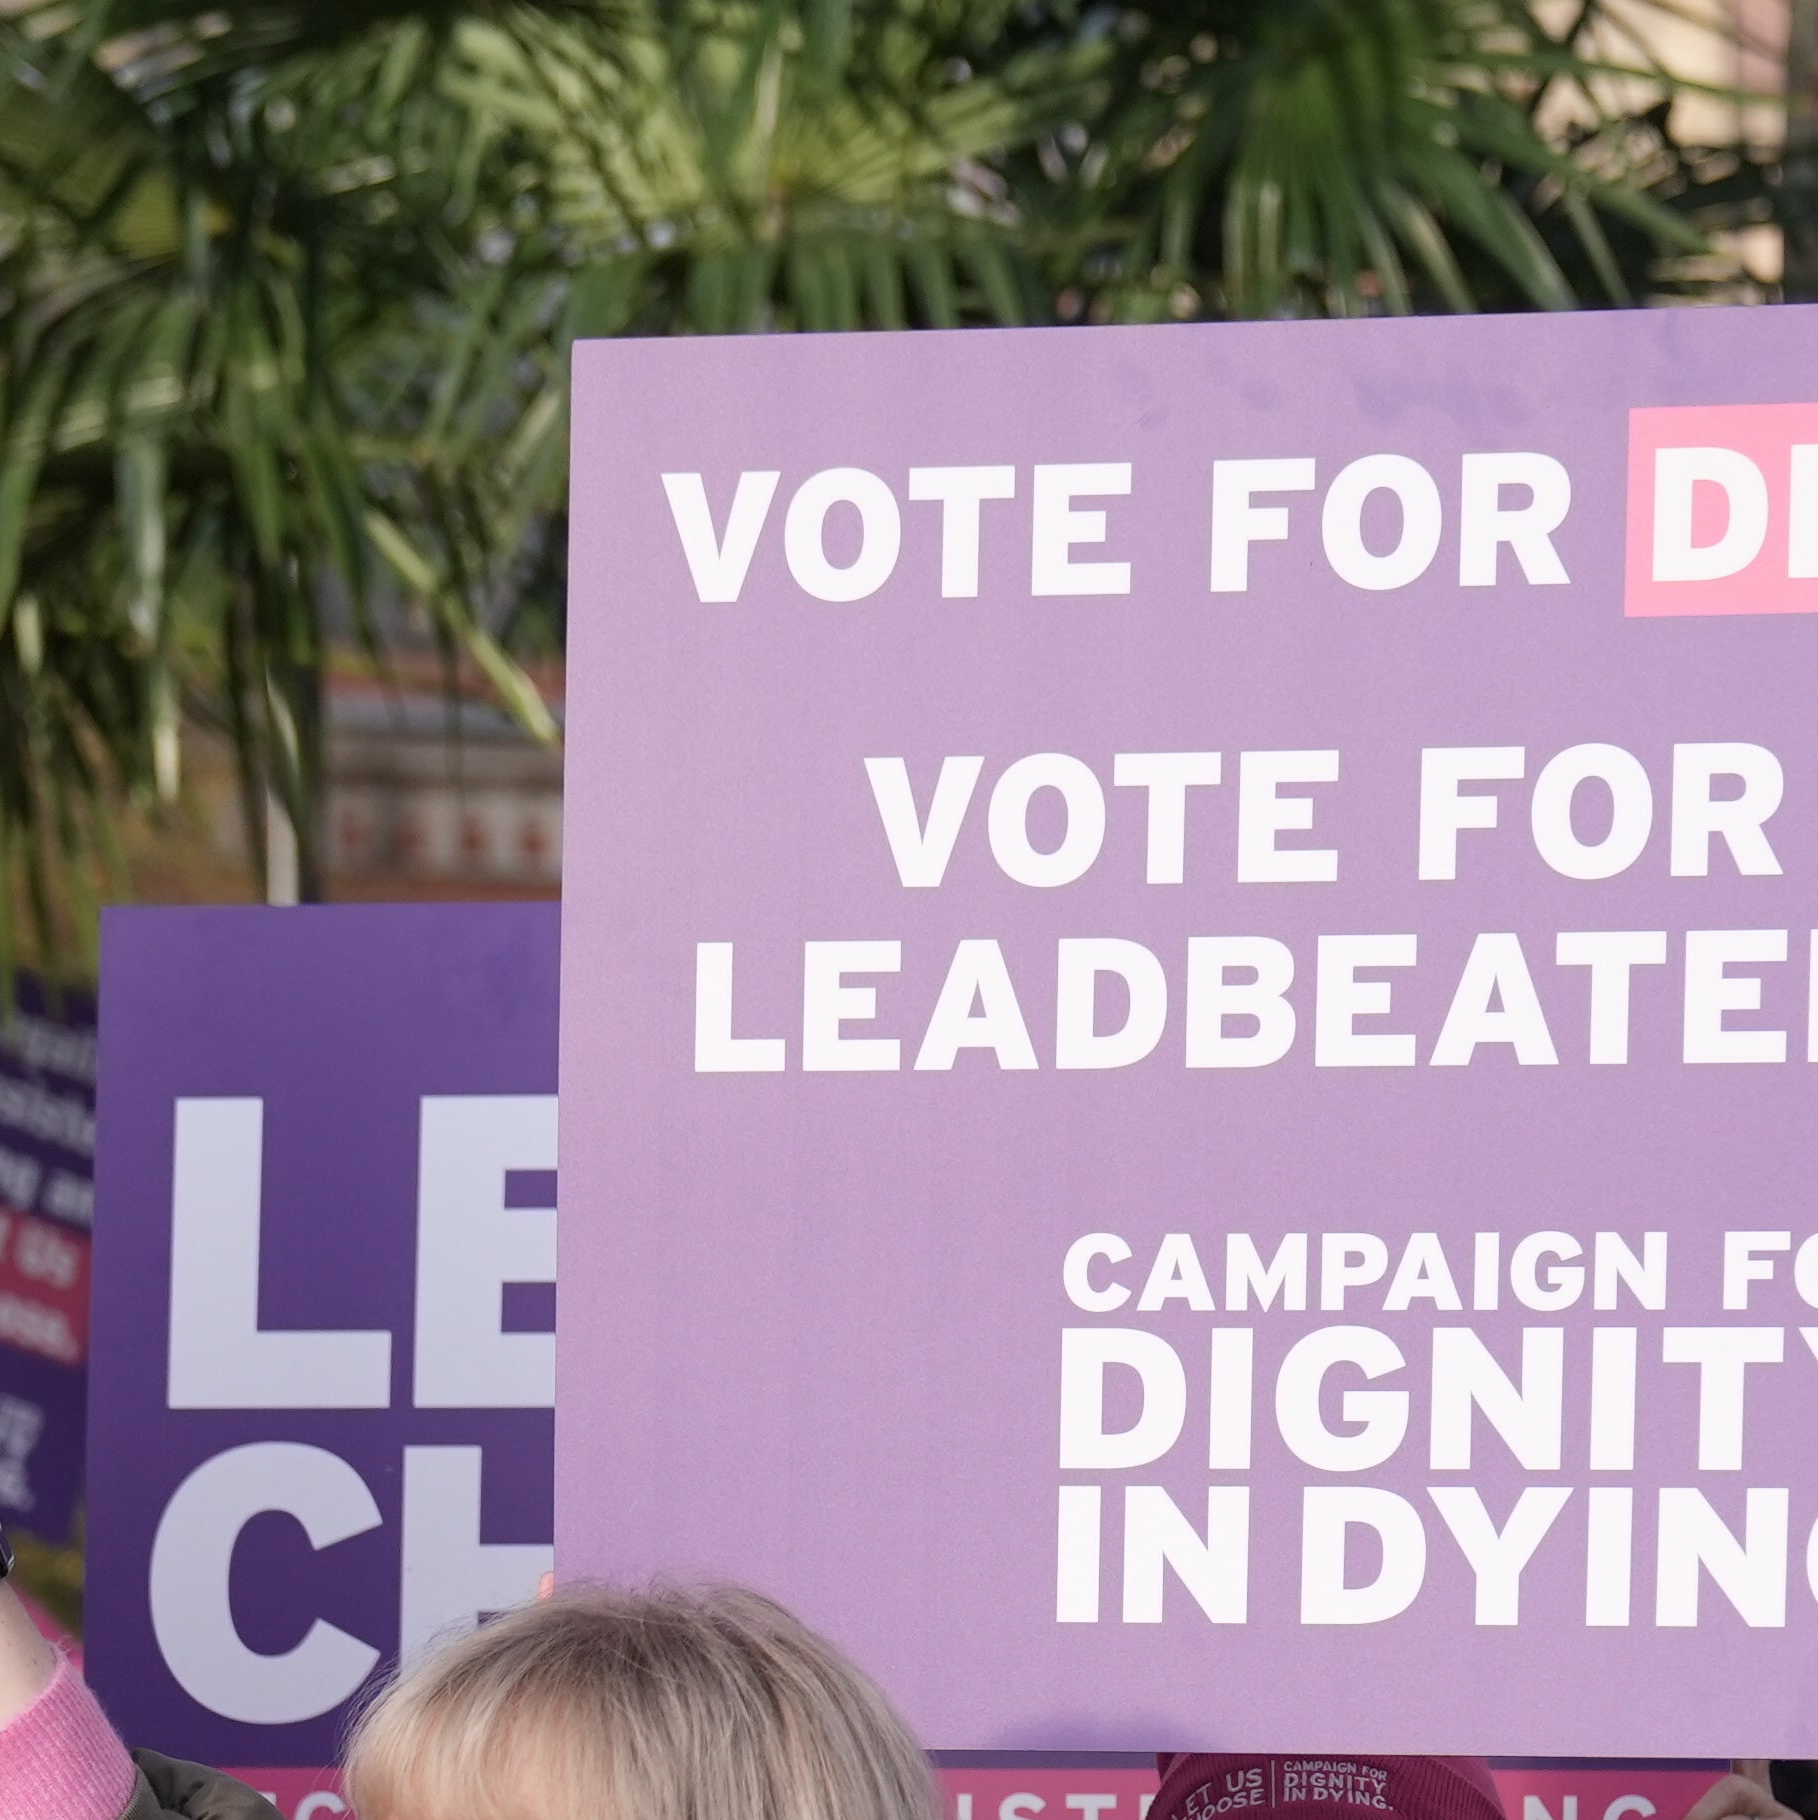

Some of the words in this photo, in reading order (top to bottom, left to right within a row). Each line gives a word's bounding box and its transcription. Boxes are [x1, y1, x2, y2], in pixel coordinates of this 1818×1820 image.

[661, 463, 1133, 604] VOTE
[1209, 450, 1573, 594] FOR
[863, 748, 1340, 889] VOTE
[1417, 741, 1785, 882] FOR
[1062, 1230, 1668, 1313] CAMPAIGN
[1056, 1485, 1250, 1625] IN
[1226, 1767, 1264, 1792] US
[1283, 1760, 1358, 1775] CAMPAIGN
[1362, 1765, 1388, 1781] FOR
[1283, 1772, 1387, 1795] DIGNITY
[1283, 1787, 1307, 1802] IN
[1313, 1787, 1395, 1812] DYING.
